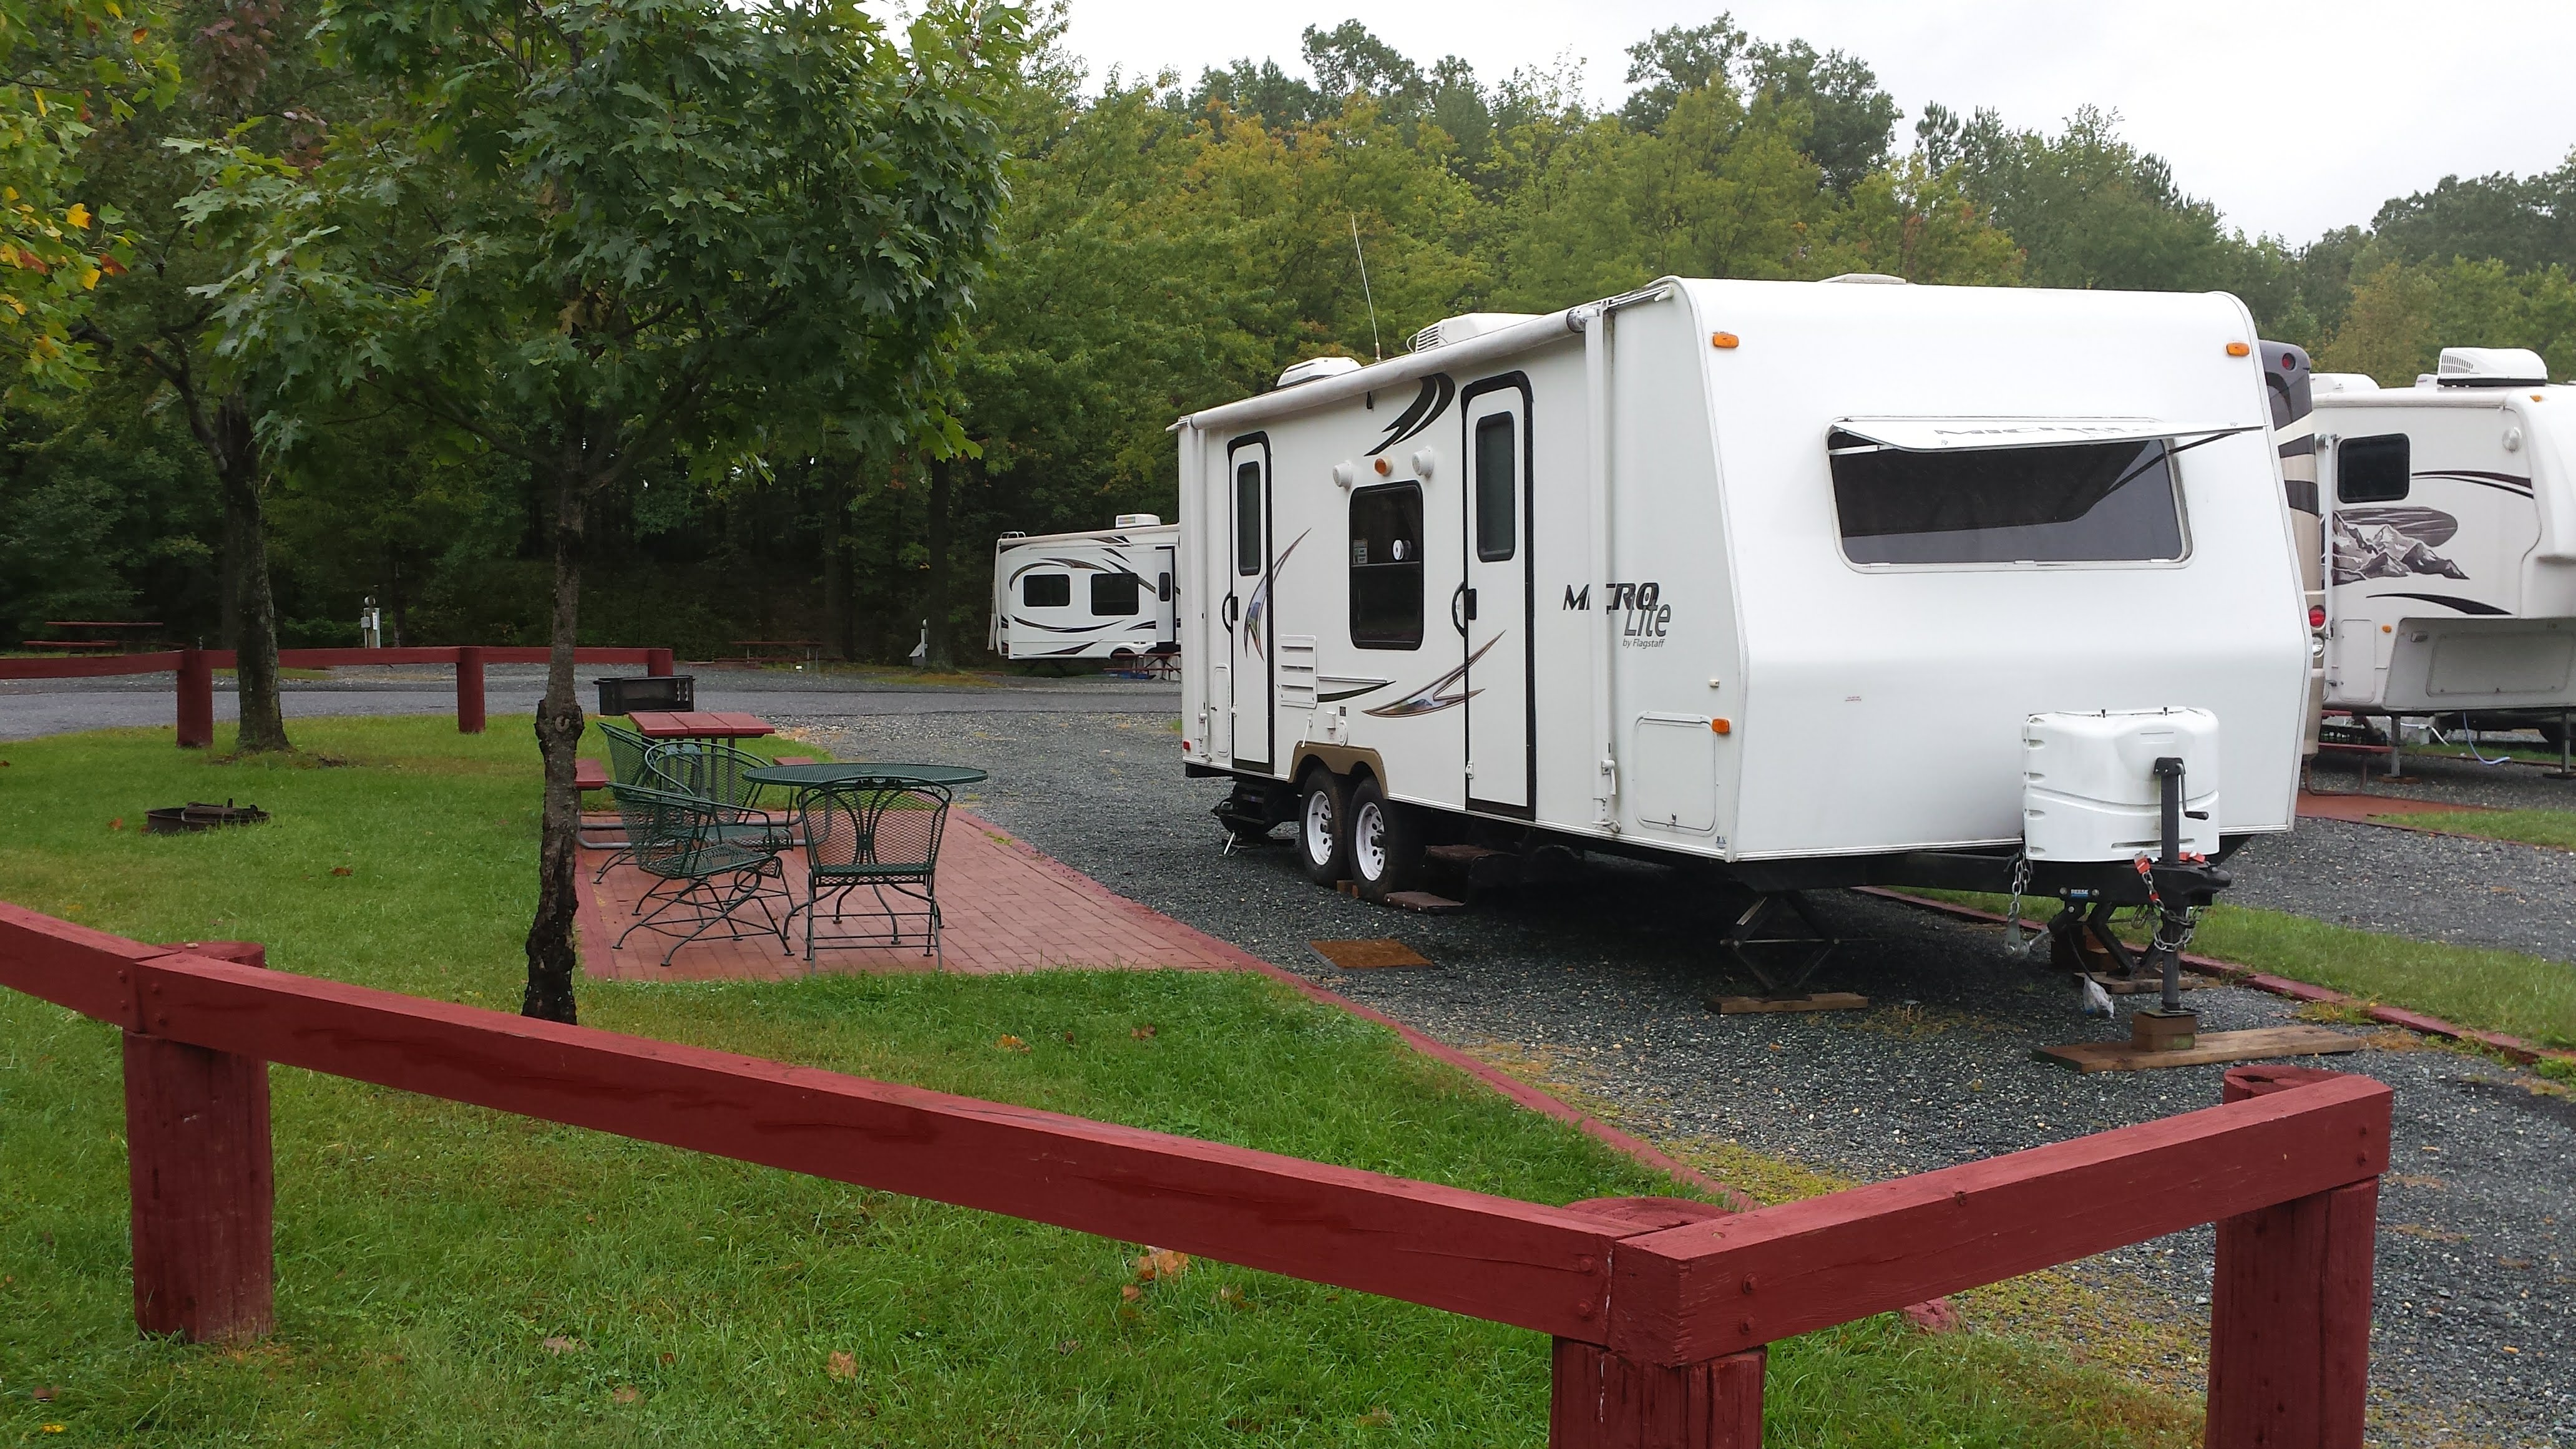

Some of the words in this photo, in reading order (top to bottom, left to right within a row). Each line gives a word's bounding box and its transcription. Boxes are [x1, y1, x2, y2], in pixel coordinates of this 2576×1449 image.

[1563, 582, 1659, 612] MRO
[1624, 593, 1671, 637] Lite
[1622, 638, 1631, 648] by
[1633, 638, 1666, 649] Flagstaff
